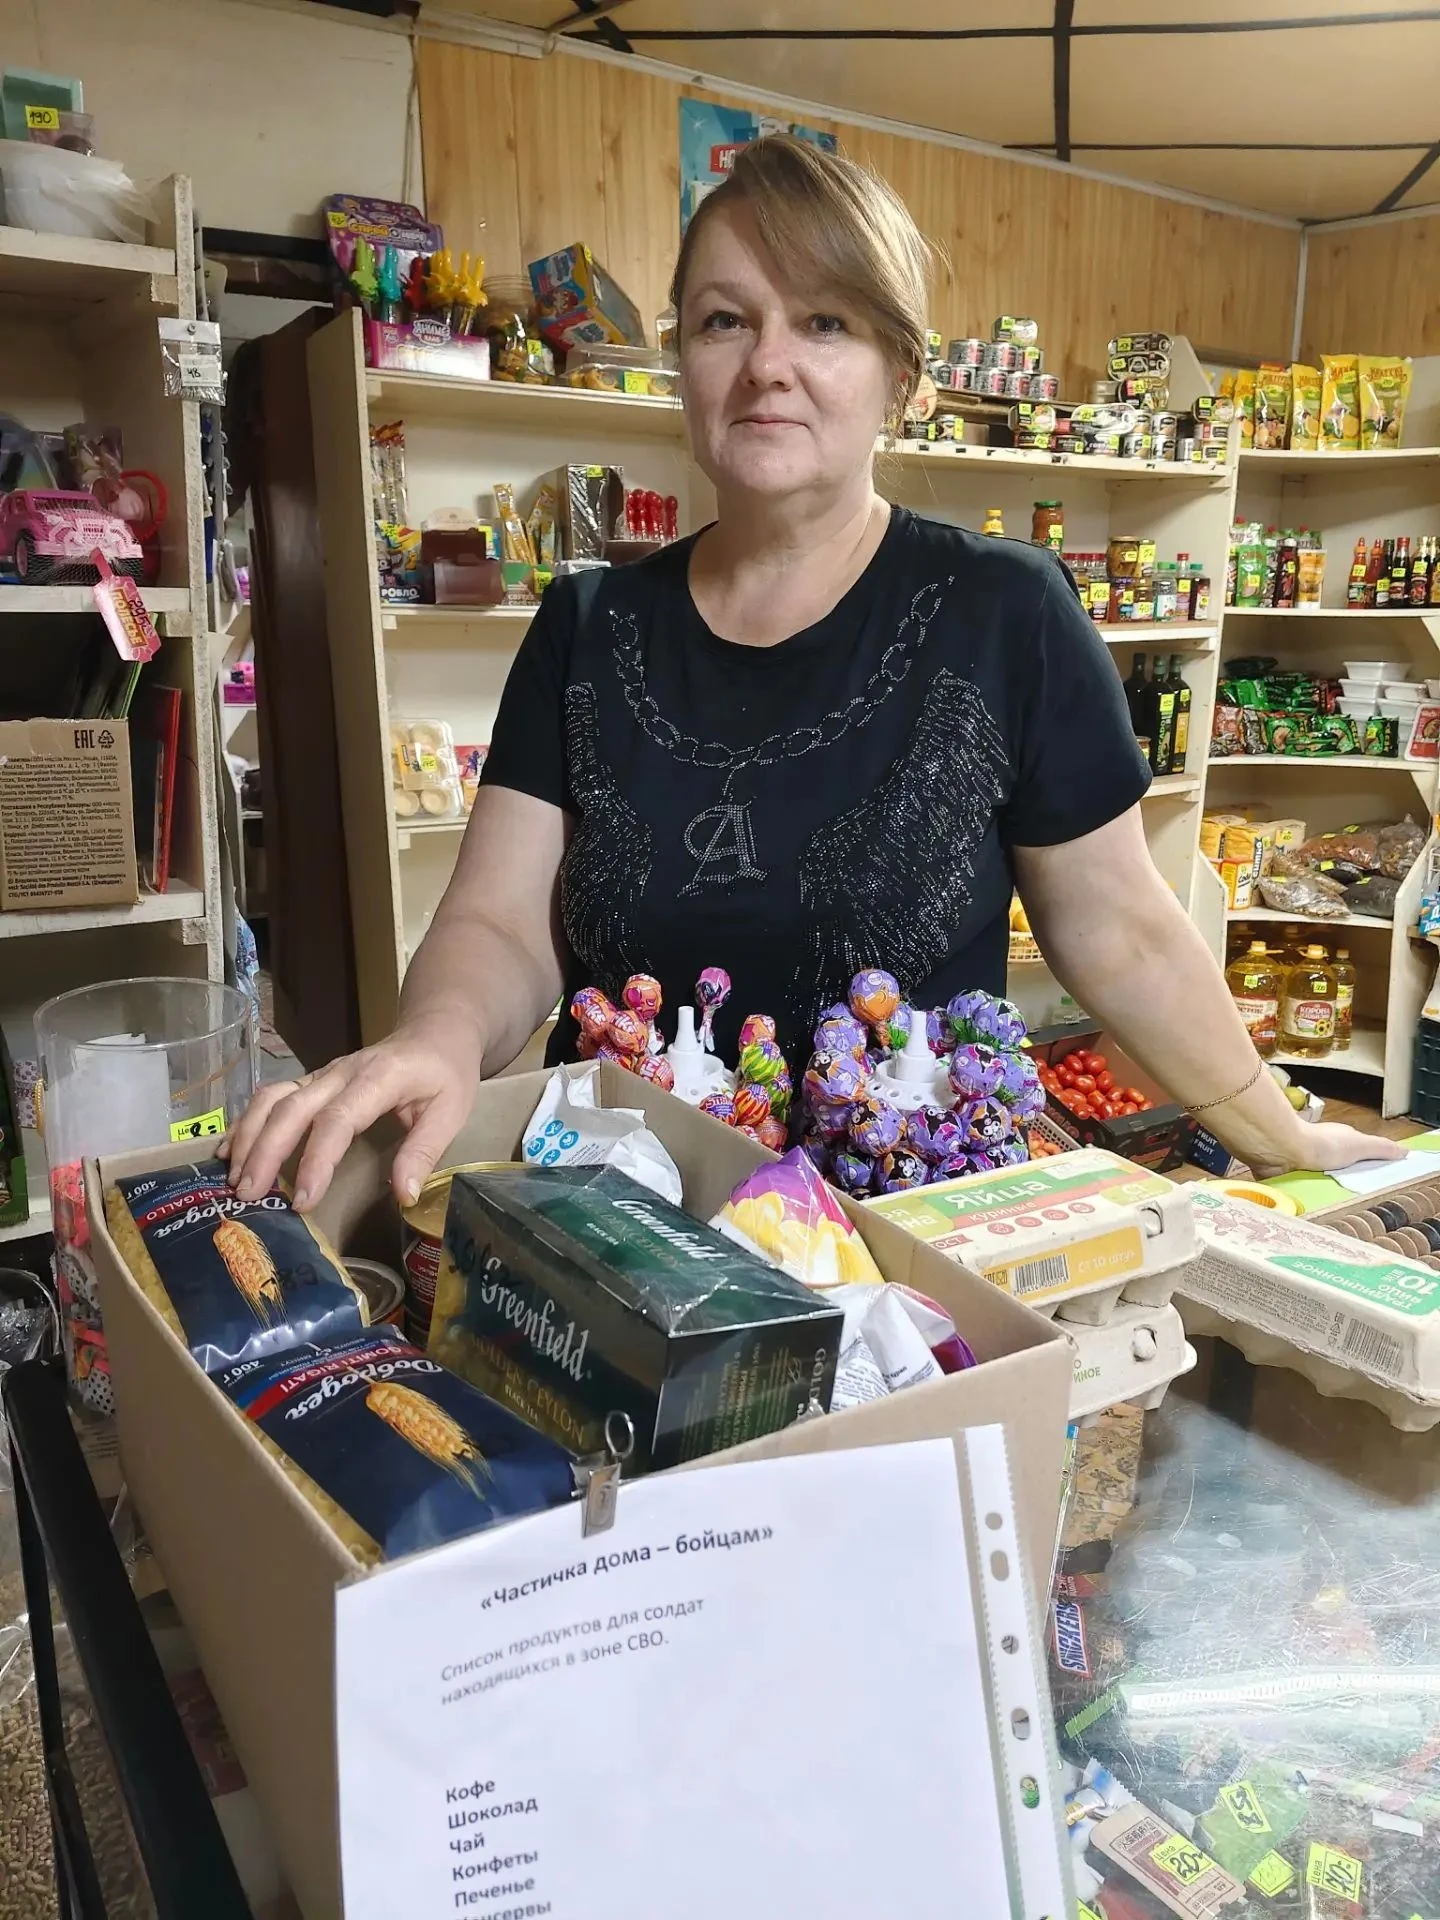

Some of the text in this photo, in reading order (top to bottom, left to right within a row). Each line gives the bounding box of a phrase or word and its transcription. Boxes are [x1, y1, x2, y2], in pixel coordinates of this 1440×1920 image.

[29, 110, 52, 124] 190
[381, 587, 418, 598] РОБЛО
[110, 591, 144, 645] ПОЛЕСЬЕ
[74, 729, 95, 749] EAC
[1193, 1138, 1214, 1155] FRUIT
[1197, 1128, 1218, 1145] FRUIT
[133, 1179, 157, 1198] 400
[146, 1193, 195, 1221] GALLO
[151, 1196, 288, 1239] Дбродея
[969, 1202, 1037, 1223] куриные
[1291, 1259, 1414, 1310] ТРАДИЦИОННОЕ
[1397, 1275, 1439, 1295] 10
[481, 1256, 589, 1382] Greenfield
[231, 1359, 261, 1377] 400
[344, 1345, 403, 1369] GOMITI
[279, 1362, 343, 1393] RIGATI
[284, 1359, 443, 1420] Добродея
[479, 1557, 588, 1611] «Частичка
[593, 1543, 652, 1575] дома
[674, 1524, 774, 1556] бойцам»
[441, 1598, 705, 1683] Список продуктов для солдат
[1056, 1602, 1087, 1672] SNICKERS
[441, 1630, 670, 1706] находящихся в зоне СВО.
[446, 1780, 496, 1803] Кофе
[448, 1798, 539, 1829] Шоколад
[449, 1832, 485, 1854] Чай
[1153, 1845, 1176, 1860] Цена
[452, 1851, 539, 1881] Конфеты
[1310, 1859, 1321, 1884] Цена
[454, 1878, 536, 1908] Печенье
[456, 1901, 552, 1920] онсервы
